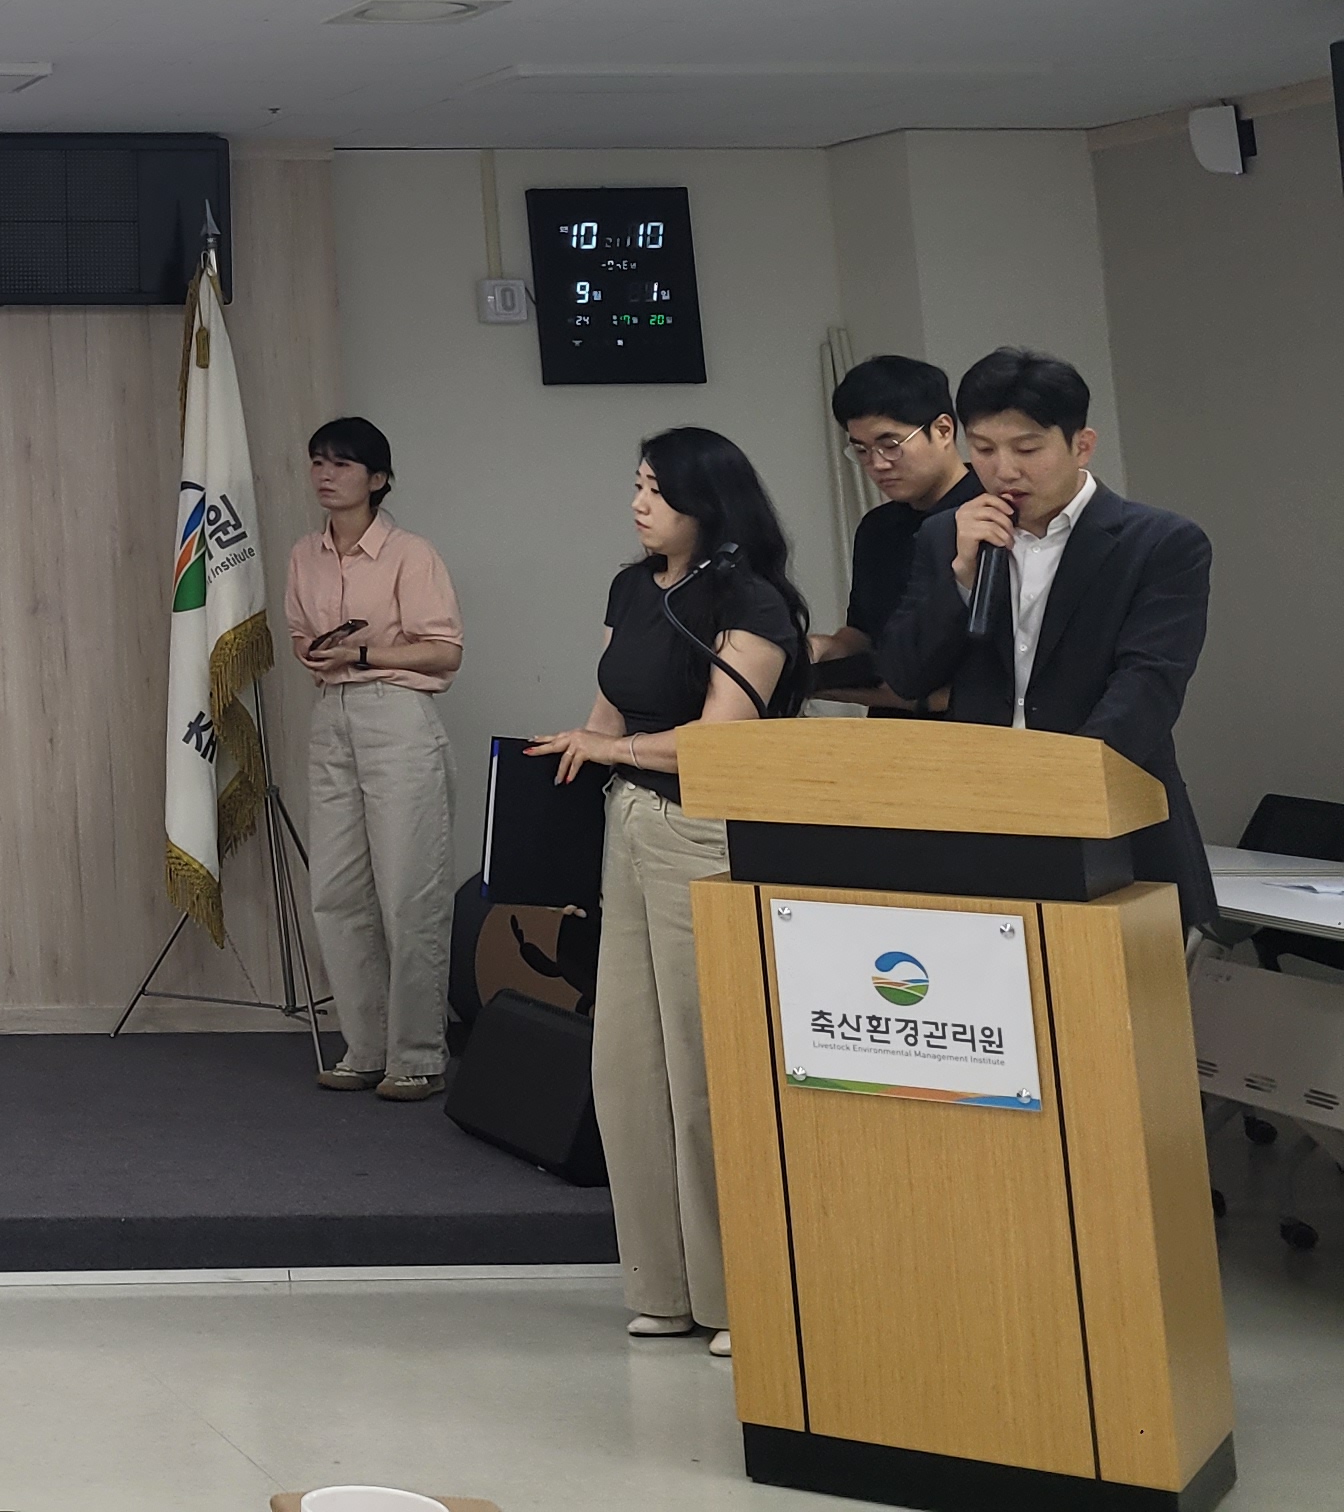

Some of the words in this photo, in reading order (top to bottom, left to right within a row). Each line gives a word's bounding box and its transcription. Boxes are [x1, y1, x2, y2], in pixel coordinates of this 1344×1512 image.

[210, 546, 255, 579] Institute
[811, 1009, 1005, 1055] 축산환경관리원
[813, 1040, 851, 1052] Livestock
[853, 1044, 912, 1058] Environmental
[914, 1051, 968, 1063] Management
[970, 1056, 1006, 1067] Institute
